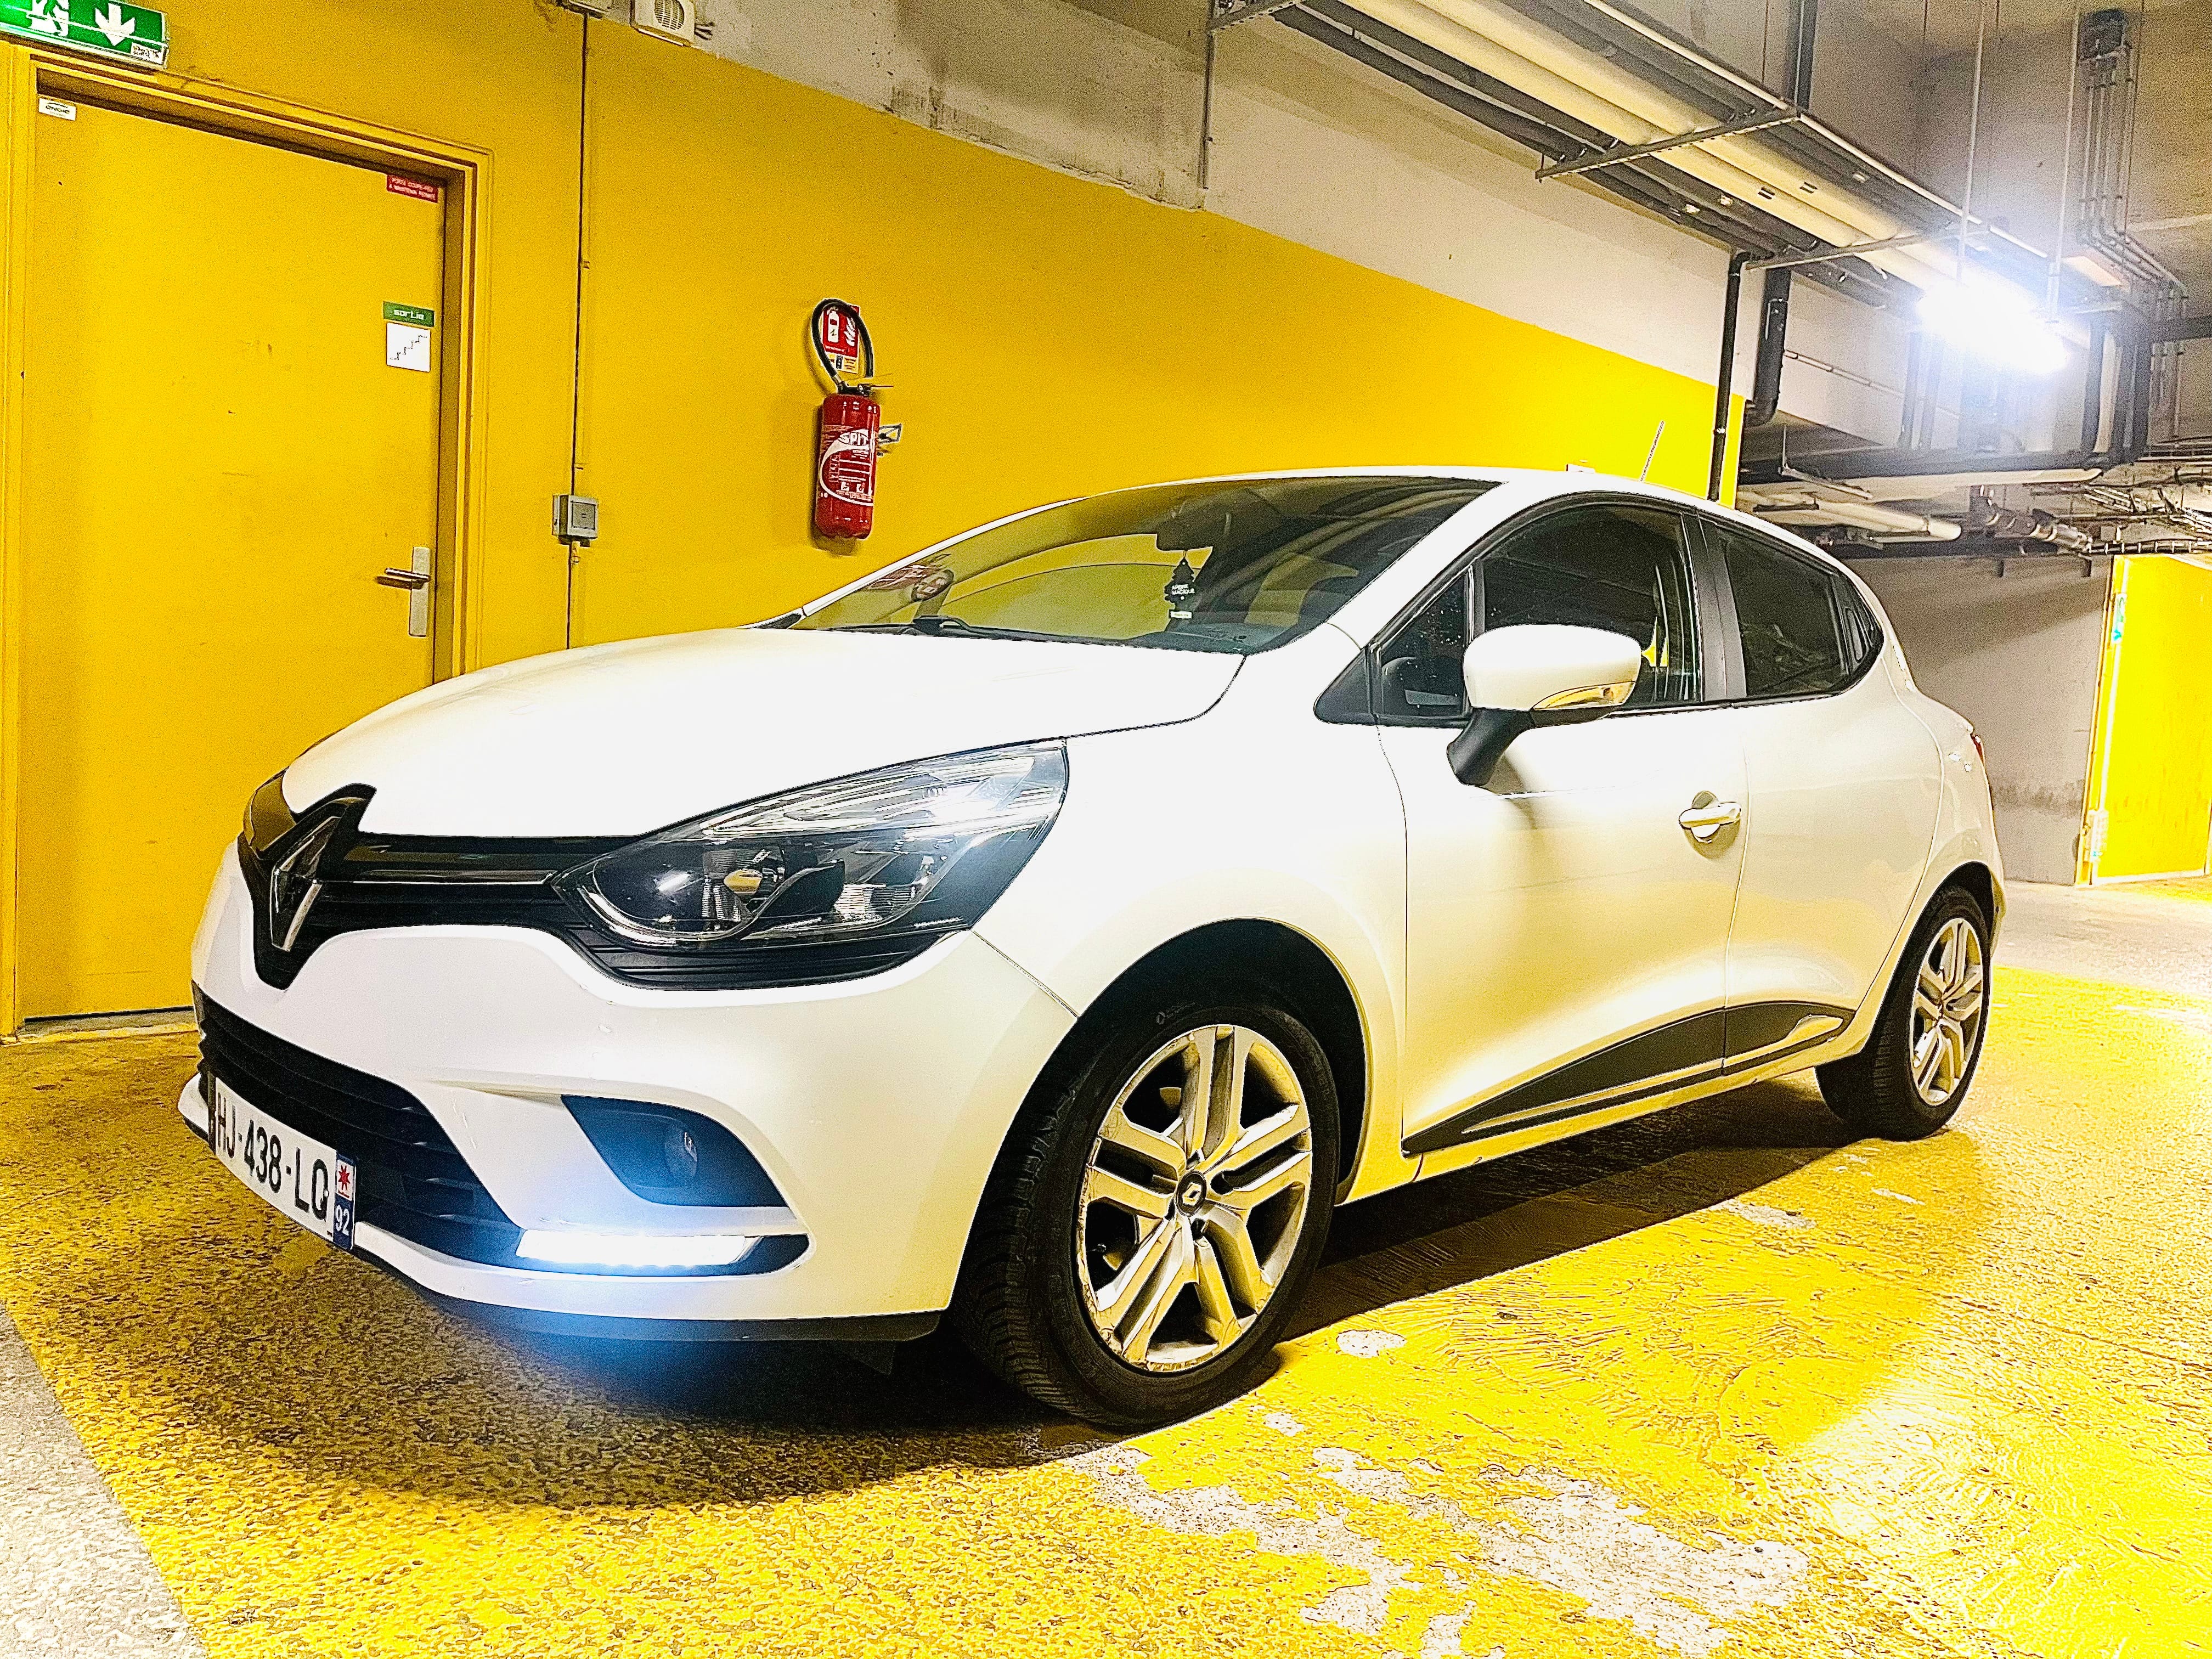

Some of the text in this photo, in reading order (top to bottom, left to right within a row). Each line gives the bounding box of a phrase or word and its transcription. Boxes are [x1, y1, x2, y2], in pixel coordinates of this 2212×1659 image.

[393, 309, 425, 320] sortie
[218, 1092, 329, 1222] HJ-438-LQ
[335, 1205, 349, 1236] 92
